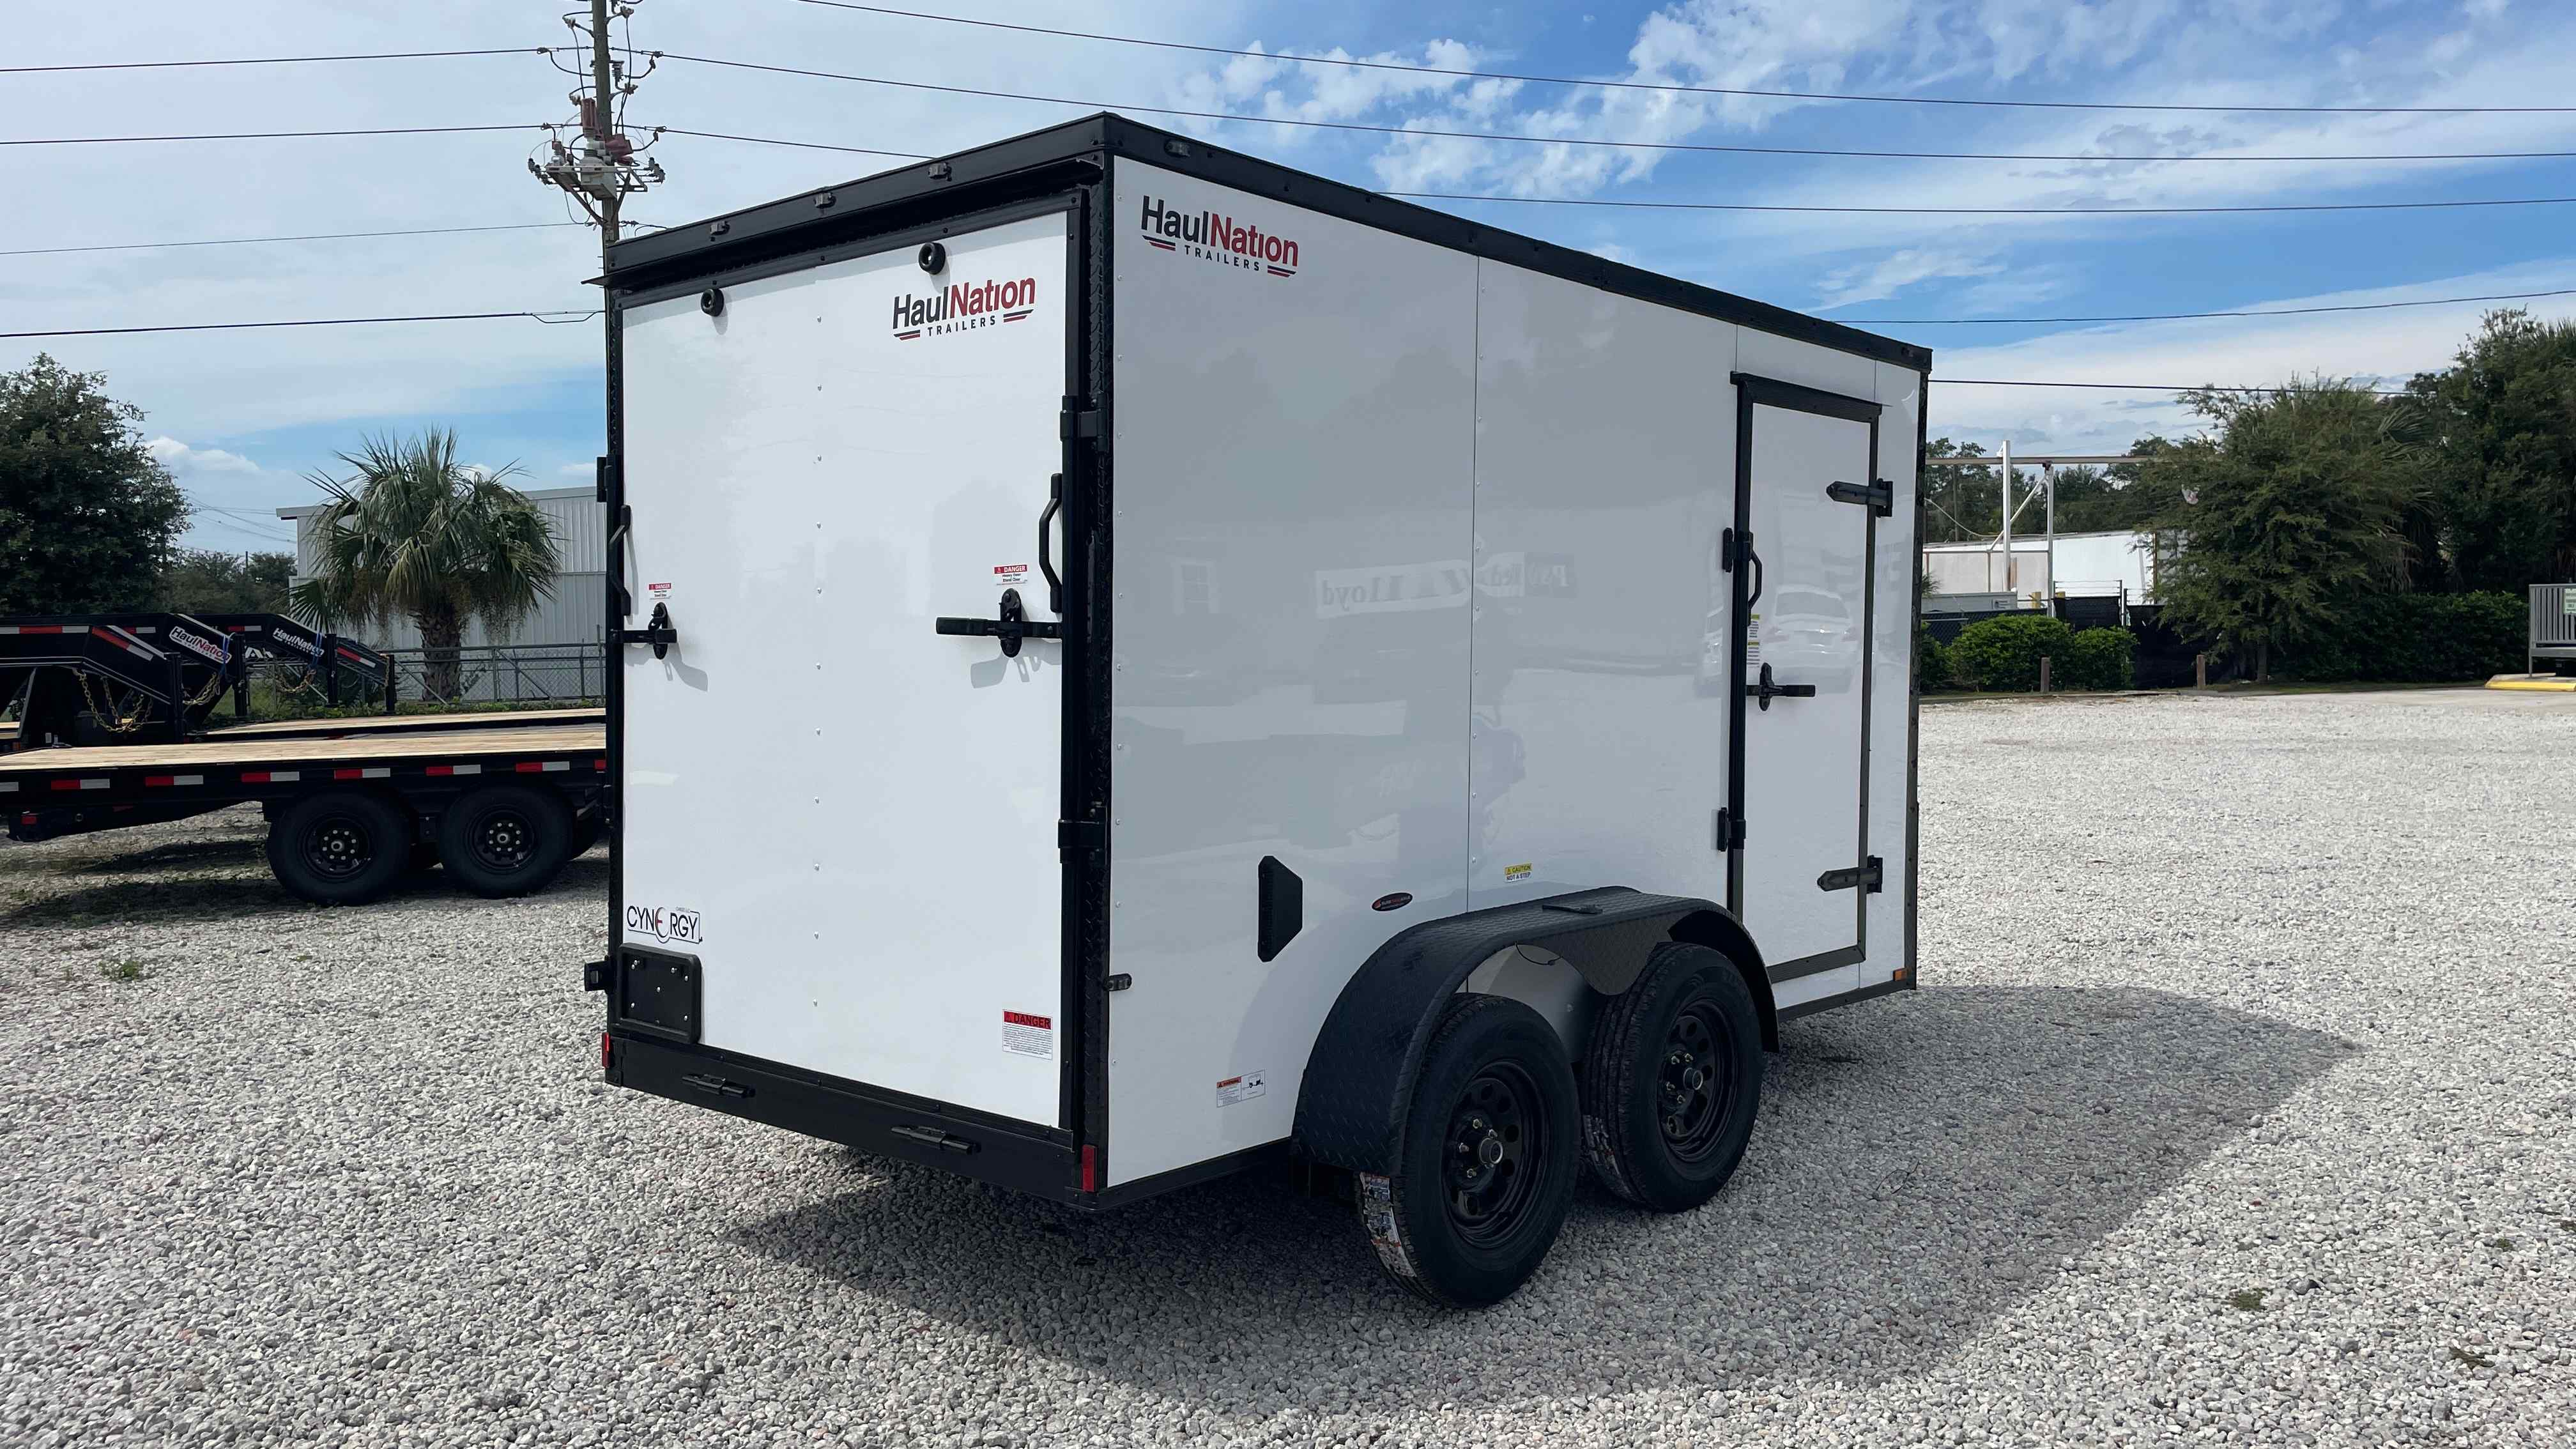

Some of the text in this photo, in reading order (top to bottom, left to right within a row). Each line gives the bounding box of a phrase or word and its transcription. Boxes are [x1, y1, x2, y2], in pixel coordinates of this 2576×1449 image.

[1141, 195, 1298, 267] HaulNation
[1184, 245, 1260, 272] TRAILERS
[893, 277, 1036, 329] HaulNation
[928, 315, 996, 337] TRAILERS
[627, 905, 698, 939] CYNERGY
[1013, 1013, 1050, 1029] DANGER
